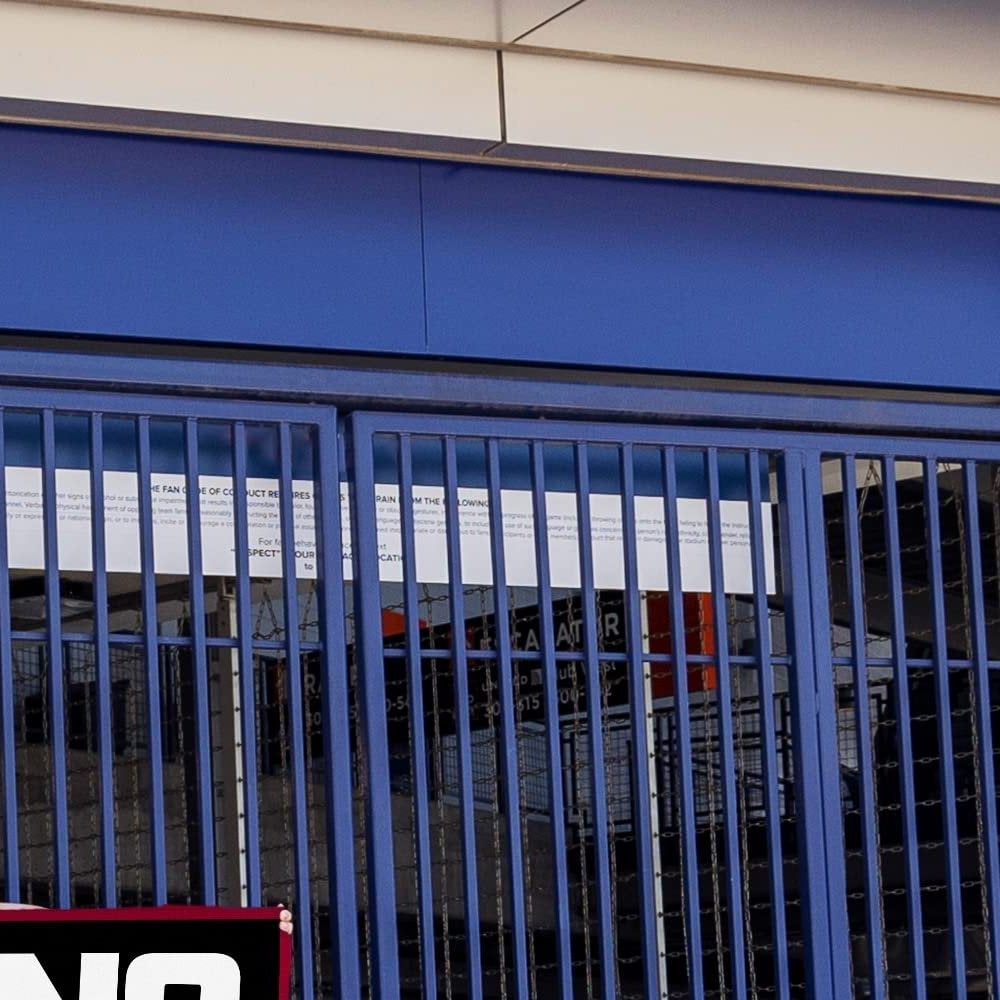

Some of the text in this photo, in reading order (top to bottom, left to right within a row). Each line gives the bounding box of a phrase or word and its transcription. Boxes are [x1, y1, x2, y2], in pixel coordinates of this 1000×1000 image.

[162, 485, 180, 494] FAN
[208, 487, 221, 496] OF
[424, 497, 441, 506] THE
[304, 563, 314, 571] to
